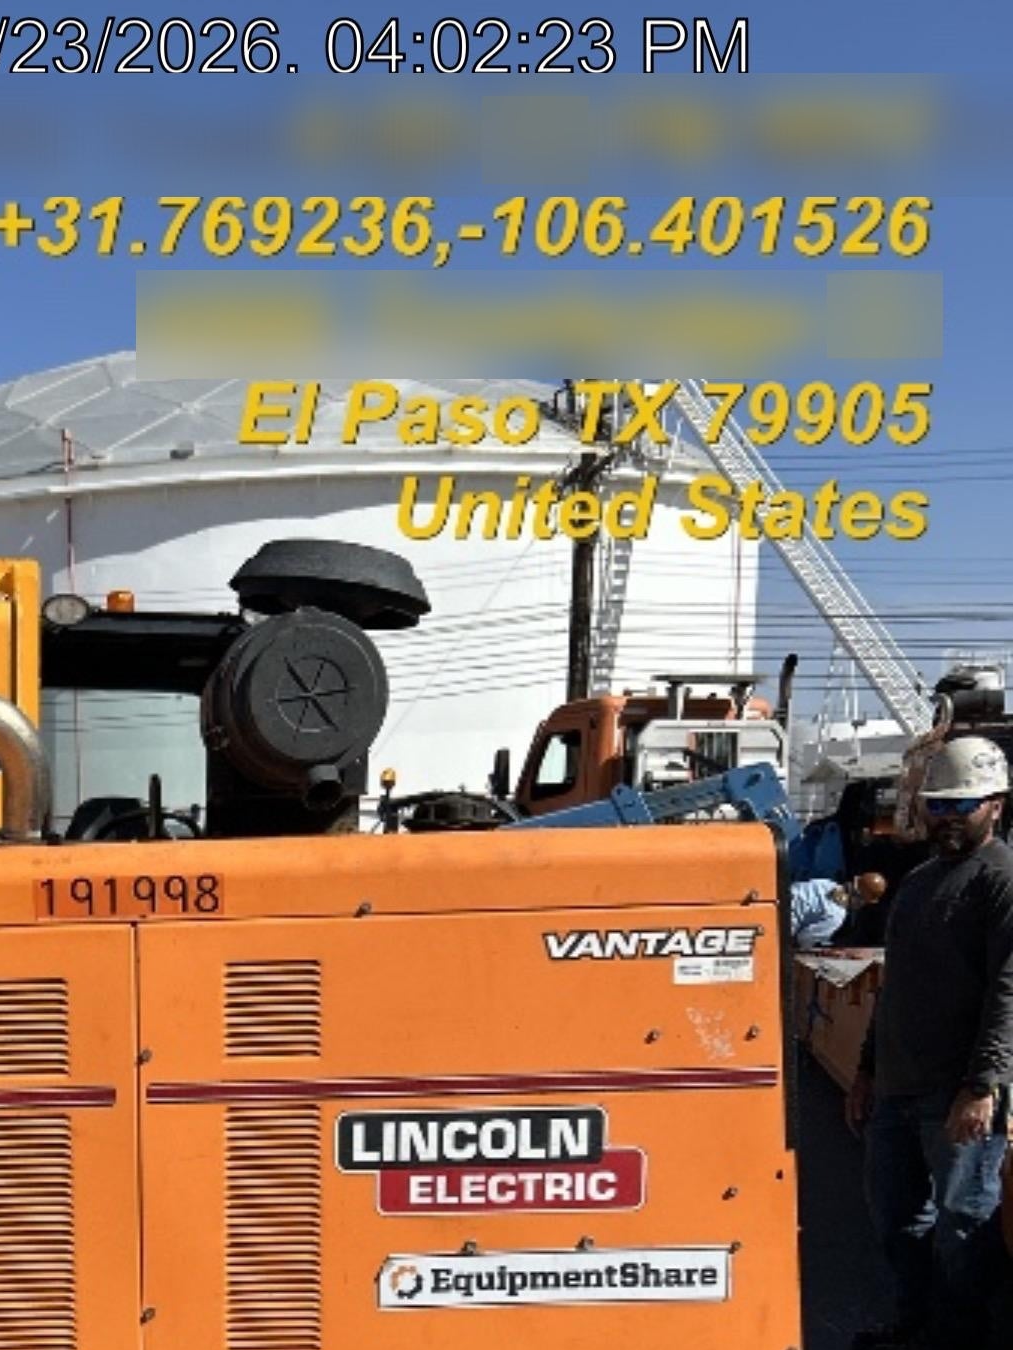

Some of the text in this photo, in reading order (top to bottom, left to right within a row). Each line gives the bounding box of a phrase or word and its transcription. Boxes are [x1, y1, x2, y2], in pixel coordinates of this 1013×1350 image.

[40, 873, 220, 916] 191998
[543, 927, 756, 958] VANTAGE
[351, 1117, 590, 1163] LINCOLN
[408, 1171, 618, 1206] ELECTRIC
[430, 1261, 718, 1297] EquipmentShare
